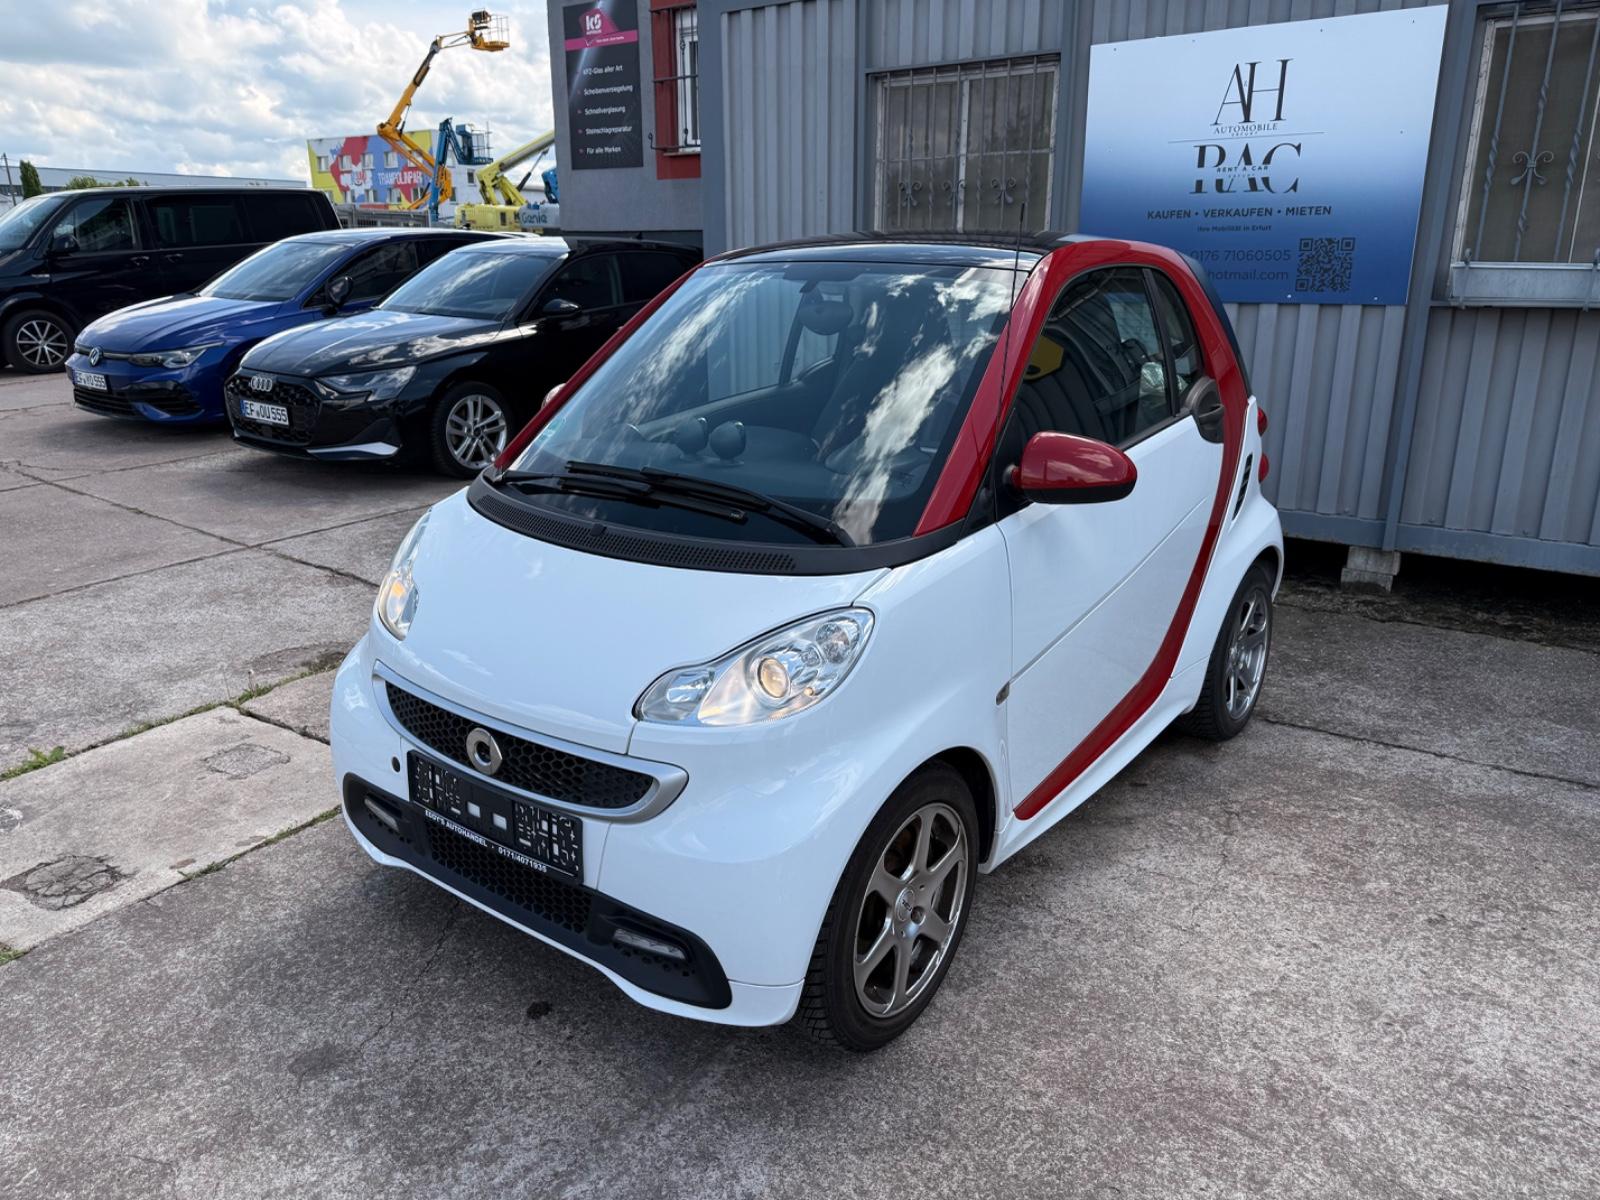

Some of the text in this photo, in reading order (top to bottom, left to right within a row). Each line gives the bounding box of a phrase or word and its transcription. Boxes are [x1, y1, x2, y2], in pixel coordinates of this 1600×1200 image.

[604, 66, 615, 74] aller
[1214, 122, 1278, 135] AUTOMOBILE
[586, 147, 595, 155] Für
[604, 146, 622, 154] Marken
[1189, 142, 1302, 194] RAC
[1216, 166, 1239, 174] RENT
[1251, 164, 1269, 172] CAR
[1147, 206, 1332, 220] KAUFEN VERKAUFEN MIETEN
[1243, 223, 1250, 232] in
[1251, 224, 1272, 232] Erfurt
[1224, 249, 1291, 262] 71060505
[446, 821, 488, 848] AUTOHANDEL
